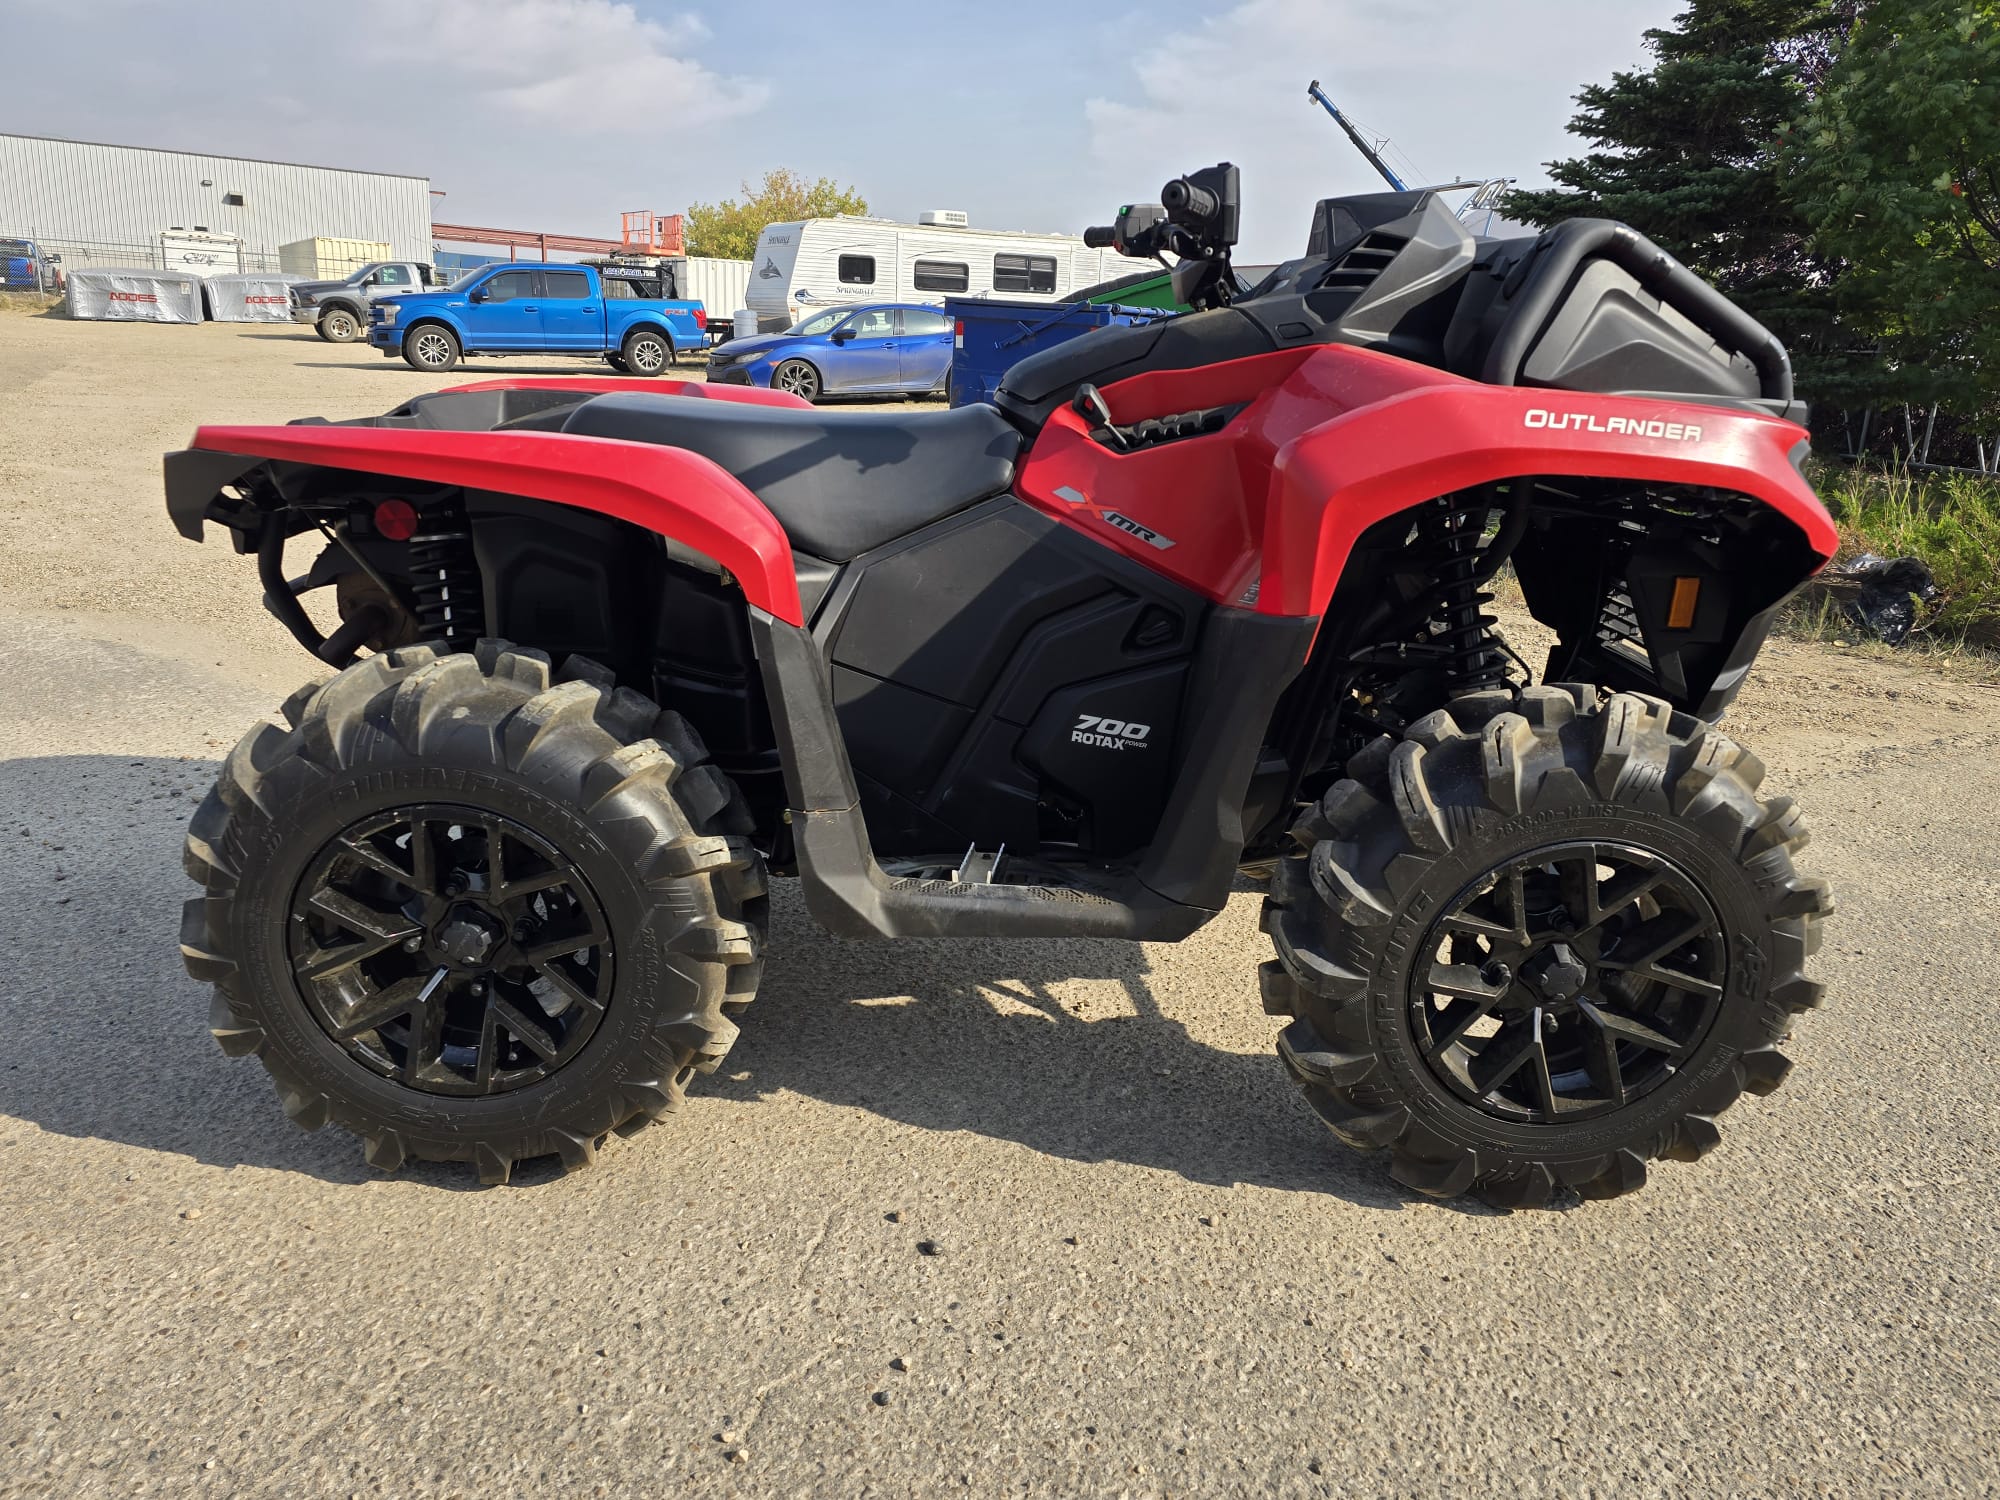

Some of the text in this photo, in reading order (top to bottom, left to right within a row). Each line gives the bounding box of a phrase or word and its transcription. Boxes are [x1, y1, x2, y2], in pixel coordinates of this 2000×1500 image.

[109, 291, 157, 303] AODES
[245, 296, 287, 304] AODES
[1524, 408, 1703, 442] OUTLANDER
[1073, 713, 1151, 740] 700
[1071, 730, 1148, 751] ROTAX POWER
